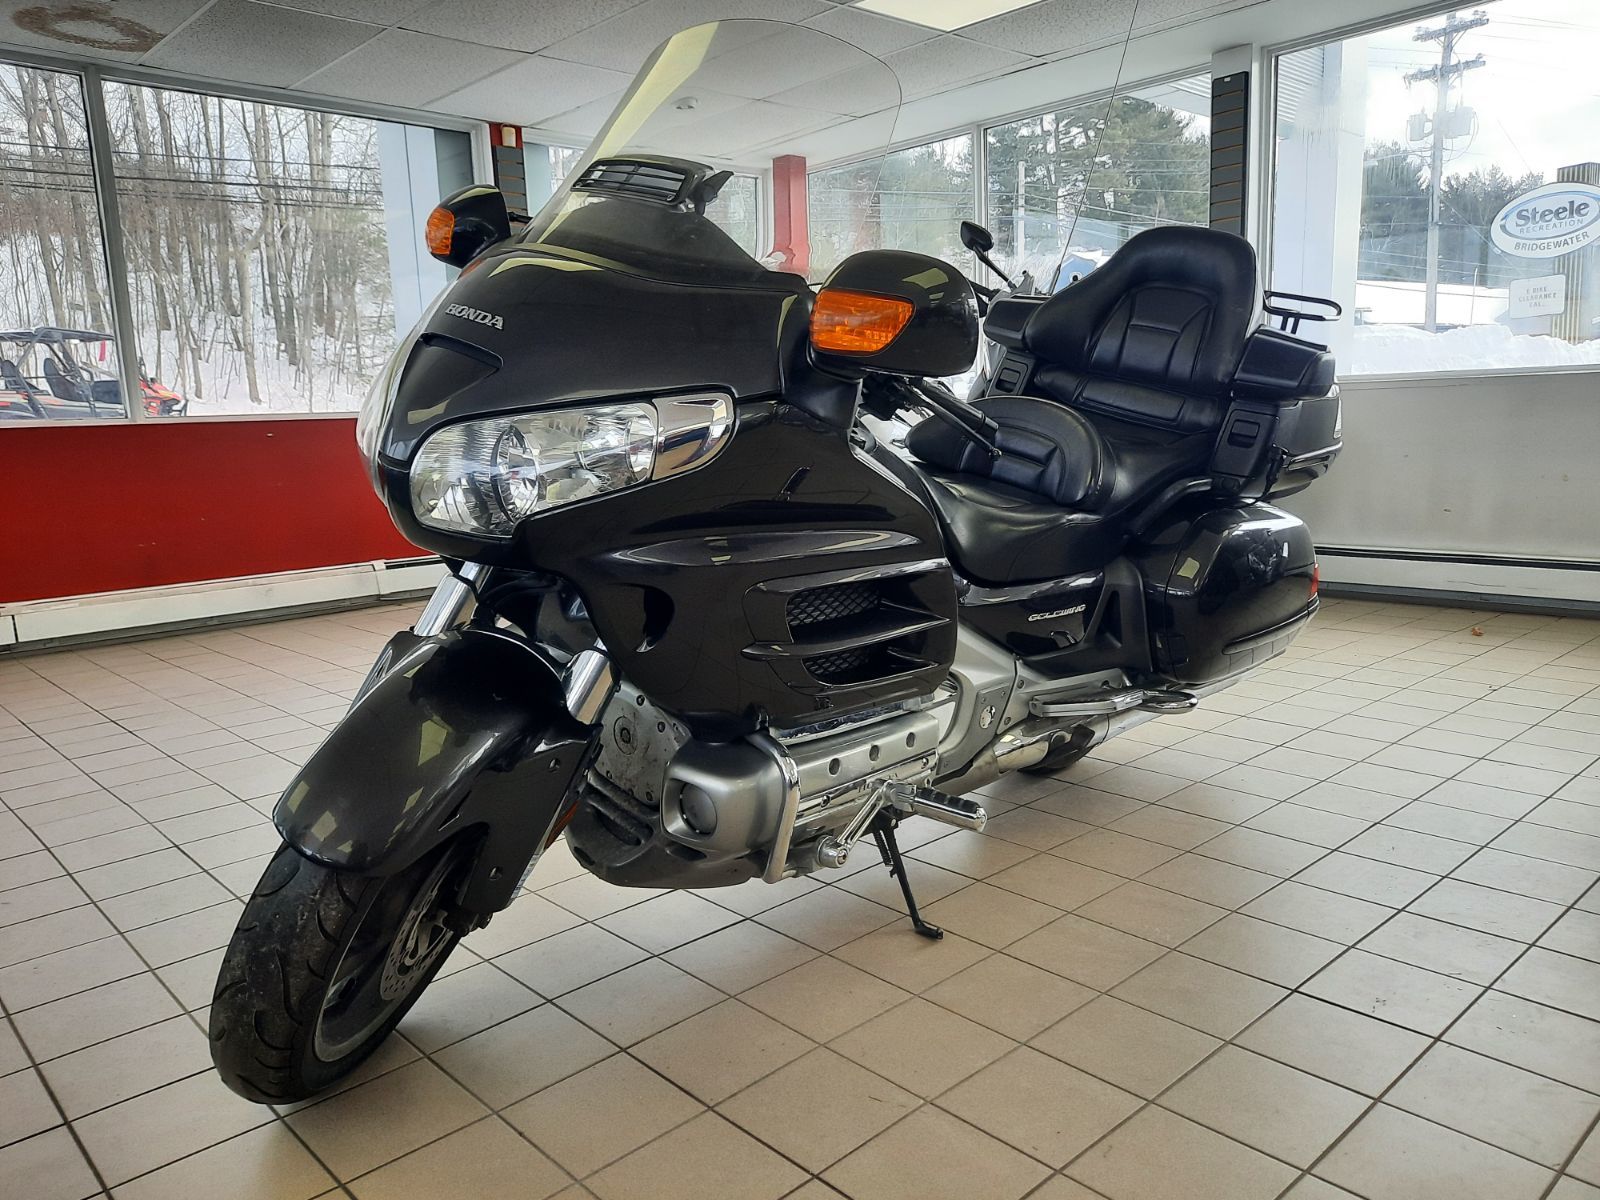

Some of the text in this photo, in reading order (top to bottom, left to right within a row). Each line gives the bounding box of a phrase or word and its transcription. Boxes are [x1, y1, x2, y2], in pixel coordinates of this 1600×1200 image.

[1515, 200, 1590, 228] Steele
[1519, 218, 1584, 235] RECREATION
[1514, 231, 1590, 252] BRIDGEWATER
[445, 303, 504, 330] HONDA
